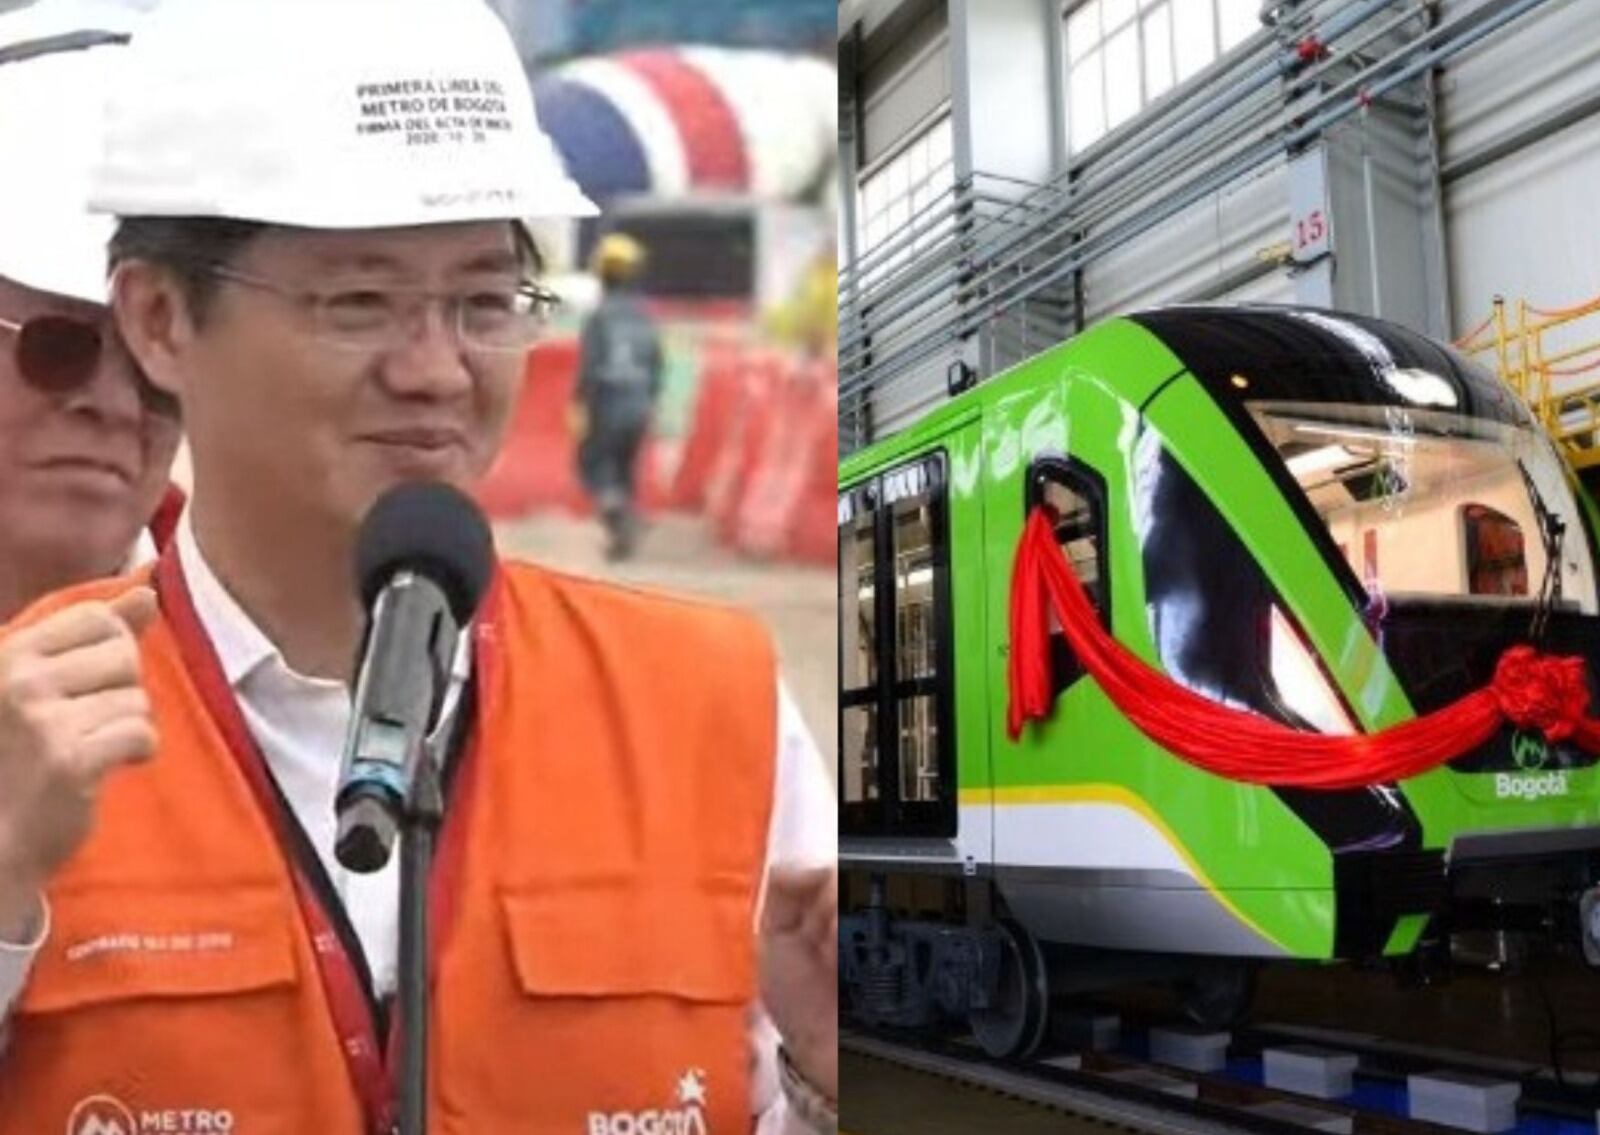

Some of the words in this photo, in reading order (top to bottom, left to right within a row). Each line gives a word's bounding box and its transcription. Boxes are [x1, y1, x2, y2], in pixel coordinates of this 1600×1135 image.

[357, 79, 435, 97] PRIMERA
[361, 98, 424, 116] METRO
[428, 98, 448, 112] DE
[1296, 210, 1325, 249] 15
[140, 1110, 234, 1130] METRO
